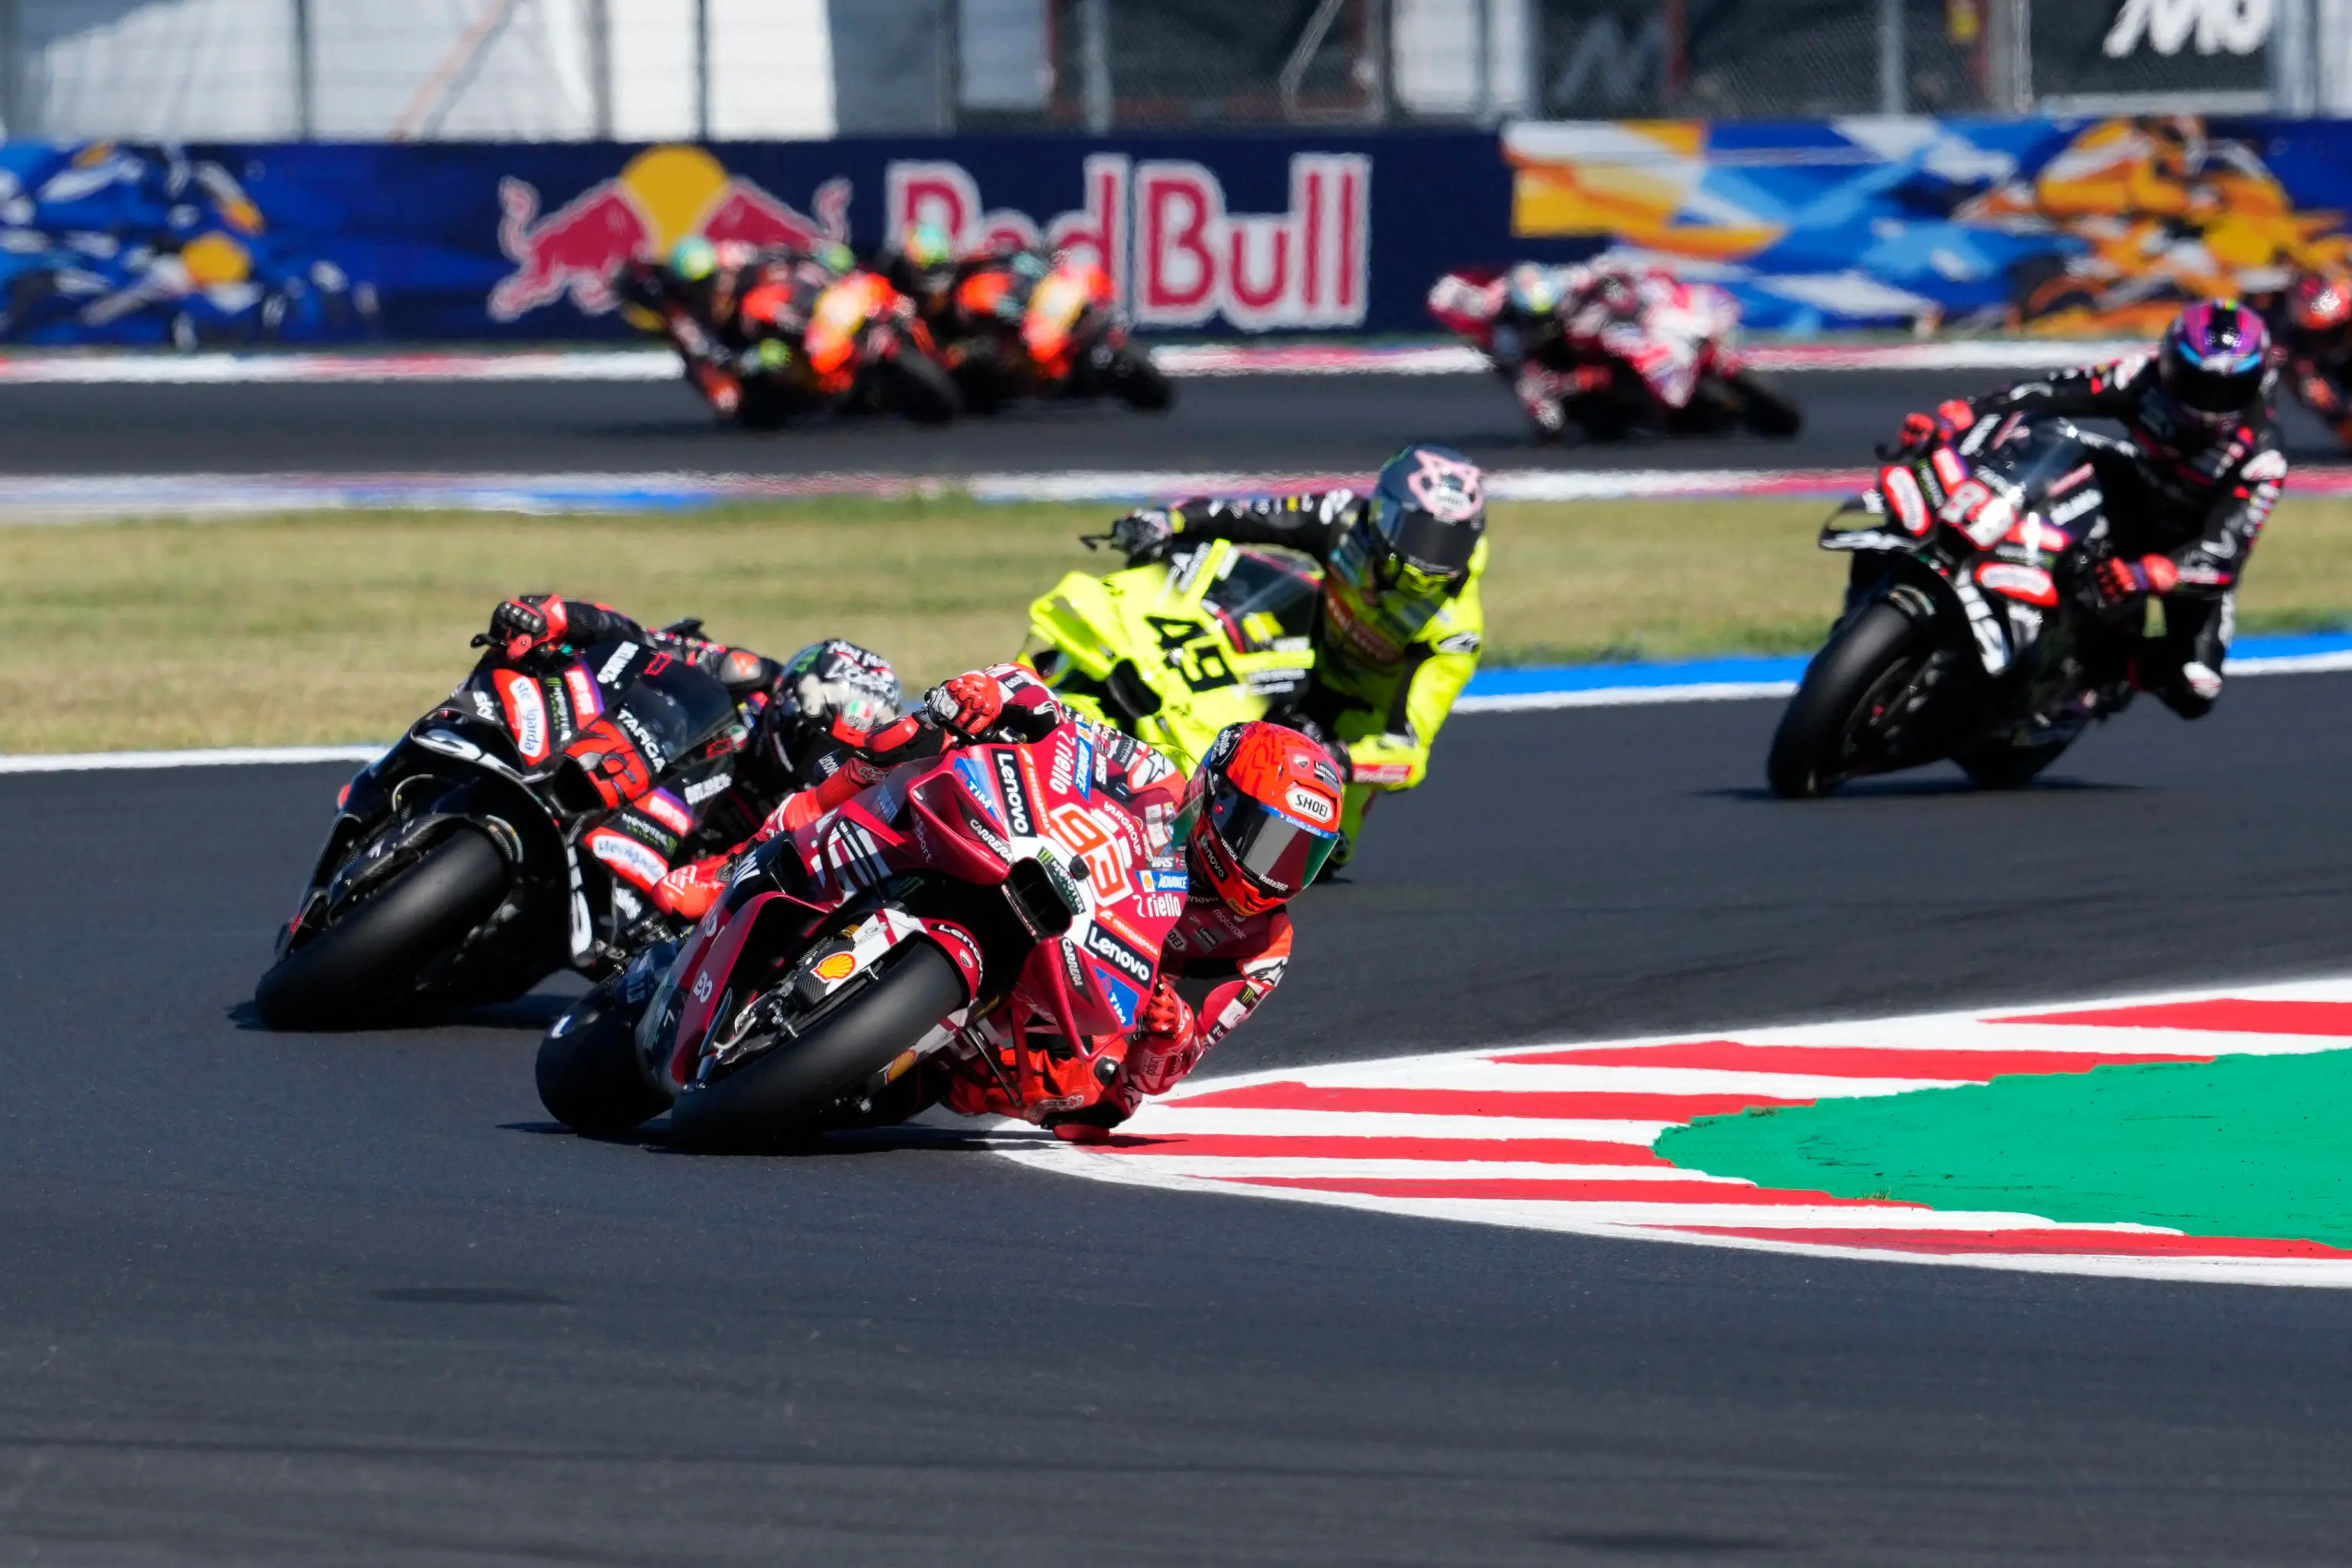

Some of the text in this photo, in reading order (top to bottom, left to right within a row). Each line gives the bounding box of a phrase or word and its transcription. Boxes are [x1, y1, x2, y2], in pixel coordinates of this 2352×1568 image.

[1136, 153, 1372, 331] Bull
[1146, 616, 1239, 694] 49
[517, 681, 541, 752] stelgarda
[617, 709, 666, 773] TARGA
[997, 753, 1030, 834] Lenovo
[1050, 741, 1075, 795] riello
[968, 781, 993, 809] TIM
[1295, 793, 1329, 818] SHOEI
[970, 818, 1014, 863] CARRERA
[1051, 861, 1085, 913] MONSTER
[1146, 893, 1181, 918] riello
[1259, 873, 1289, 891] Insta360
[1061, 938, 1085, 987] CARRERA
[1088, 926, 1150, 982] Lenovo
[1109, 991, 1127, 1025] TIM
